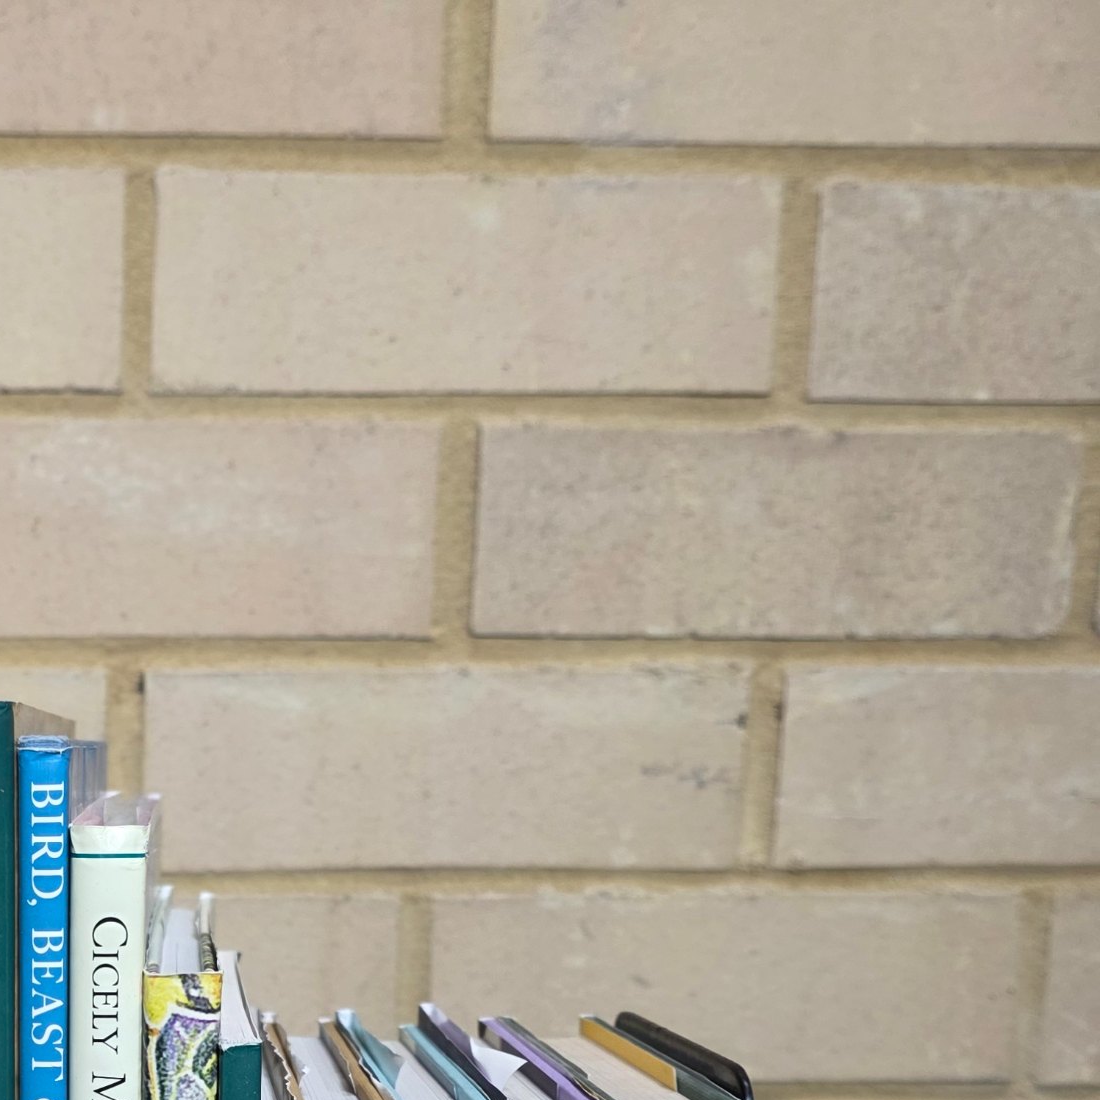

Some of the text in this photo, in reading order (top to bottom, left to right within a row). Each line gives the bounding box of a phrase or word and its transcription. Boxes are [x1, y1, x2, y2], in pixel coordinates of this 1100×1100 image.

[27, 782, 65, 906] BIRD,
[32, 928, 64, 1082] BEAST
[92, 916, 128, 1054] CICELY
